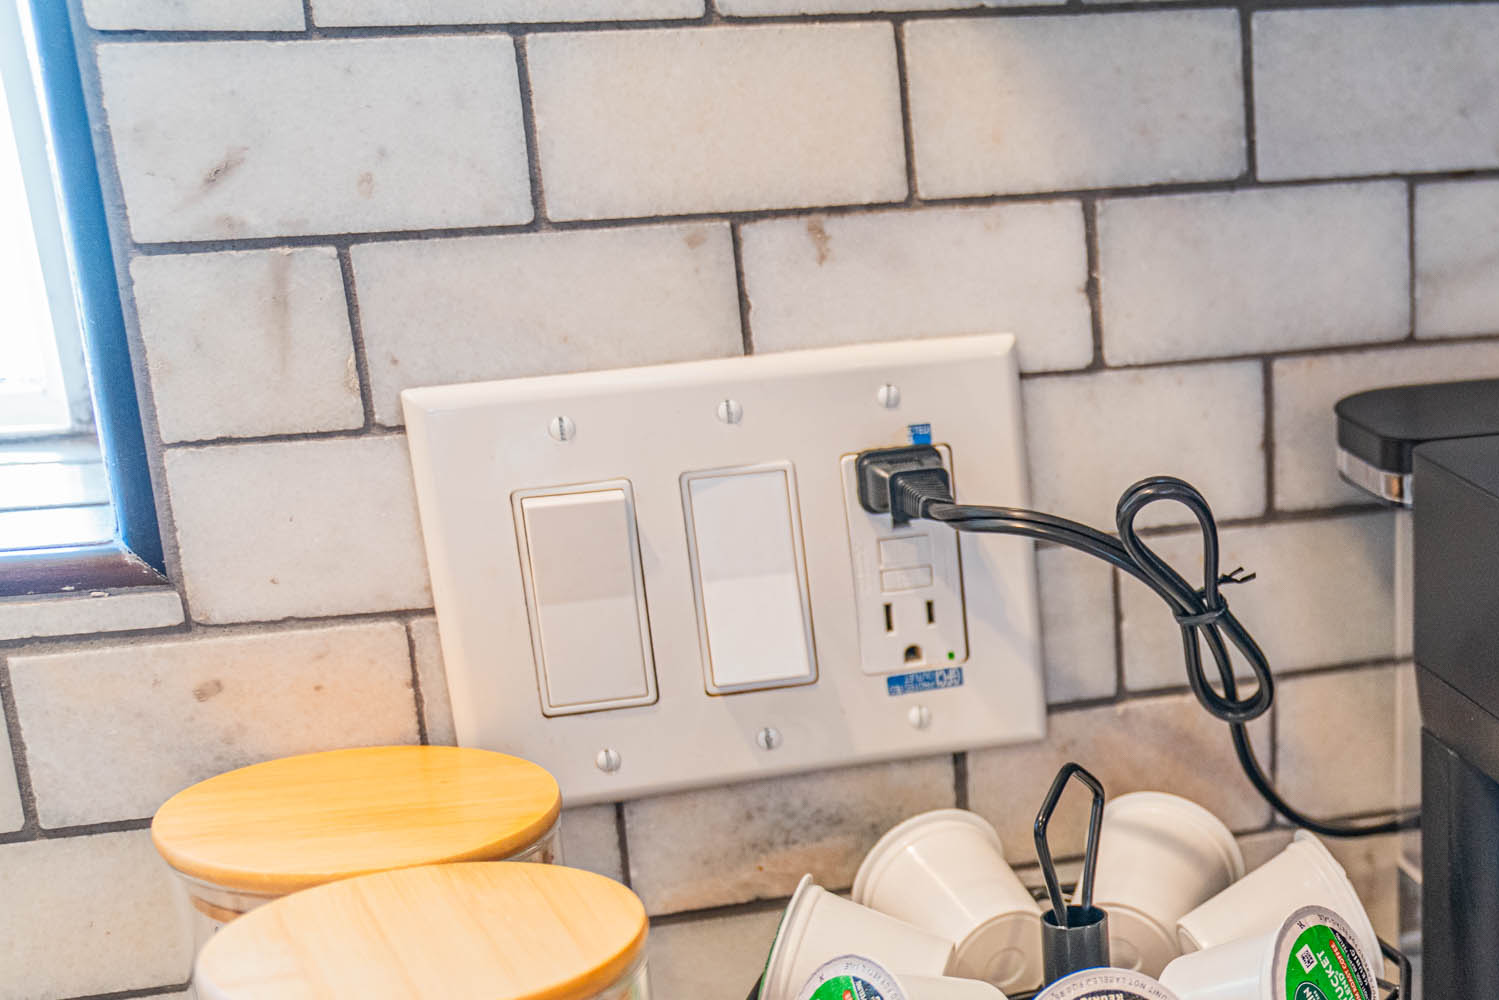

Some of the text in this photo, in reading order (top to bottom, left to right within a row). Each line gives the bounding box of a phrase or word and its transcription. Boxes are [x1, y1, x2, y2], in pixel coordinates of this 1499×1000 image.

[1330, 942, 1347, 969] COFFEE
[1349, 949, 1369, 984] KEURIG
[1344, 969, 1357, 991] ROAST
